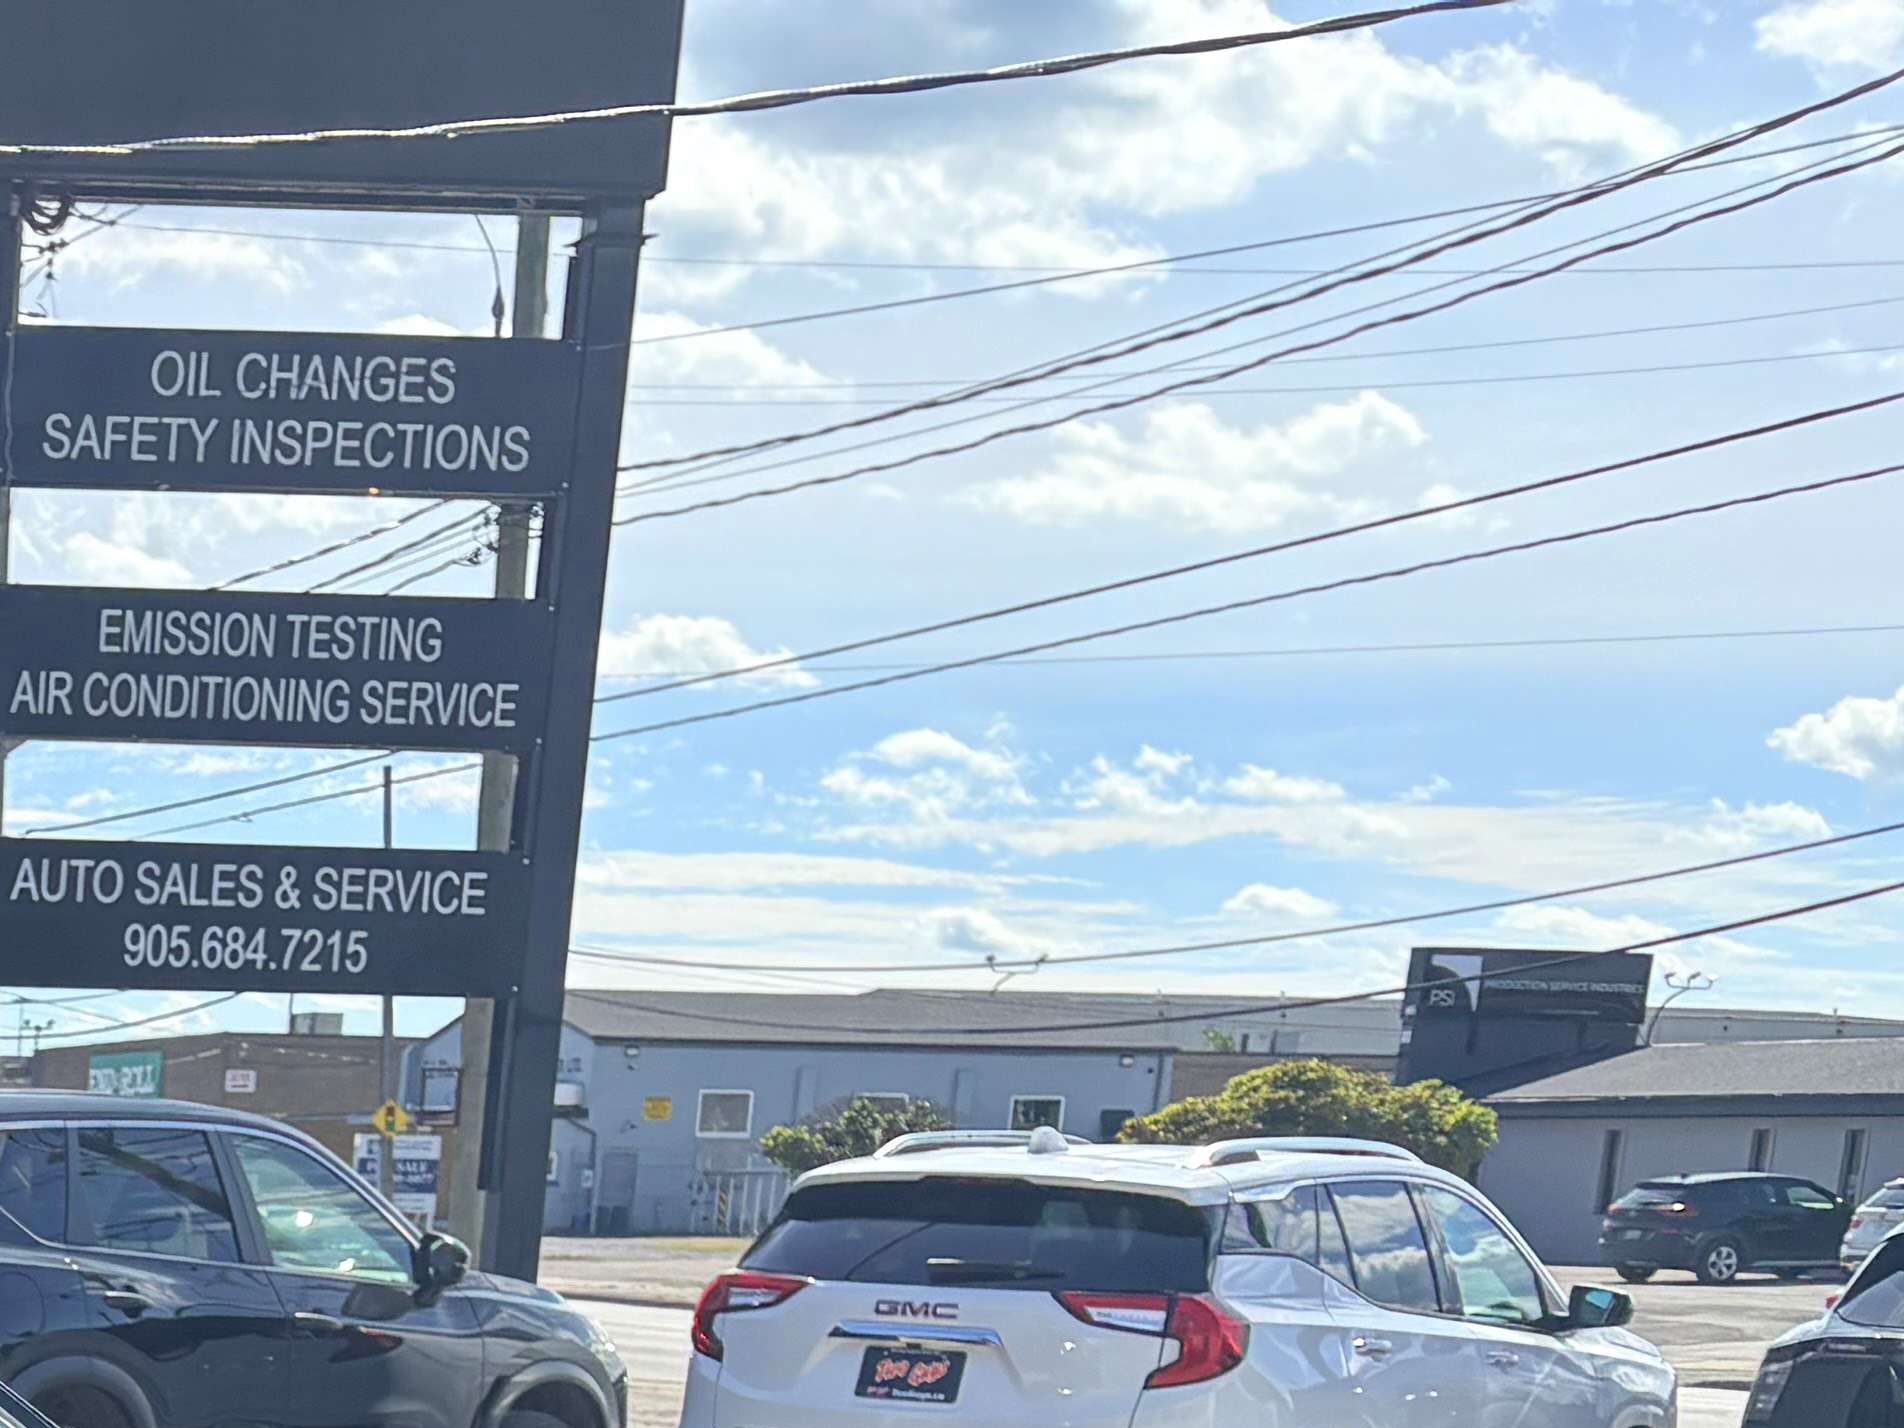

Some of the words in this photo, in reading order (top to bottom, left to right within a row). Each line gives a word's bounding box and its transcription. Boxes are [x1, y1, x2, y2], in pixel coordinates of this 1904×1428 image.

[151, 350, 222, 398] OIL
[236, 352, 457, 404] CHANGES
[42, 413, 220, 464] SAFETY
[230, 418, 531, 473] INSPECTIONS
[99, 608, 276, 658] EMISSION
[286, 613, 444, 662] TESTING
[9, 670, 74, 716] AIR
[82, 671, 351, 723] CONDITIONING
[360, 679, 520, 728] SERVICE
[9, 857, 125, 904] AUTO
[134, 861, 264, 908] SALES
[273, 865, 303, 910] &
[312, 866, 489, 916] SERVICE
[123, 922, 369, 974] 905.684.7215
[1428, 989, 1456, 1007] PSI
[873, 1299, 960, 1320] GMC
